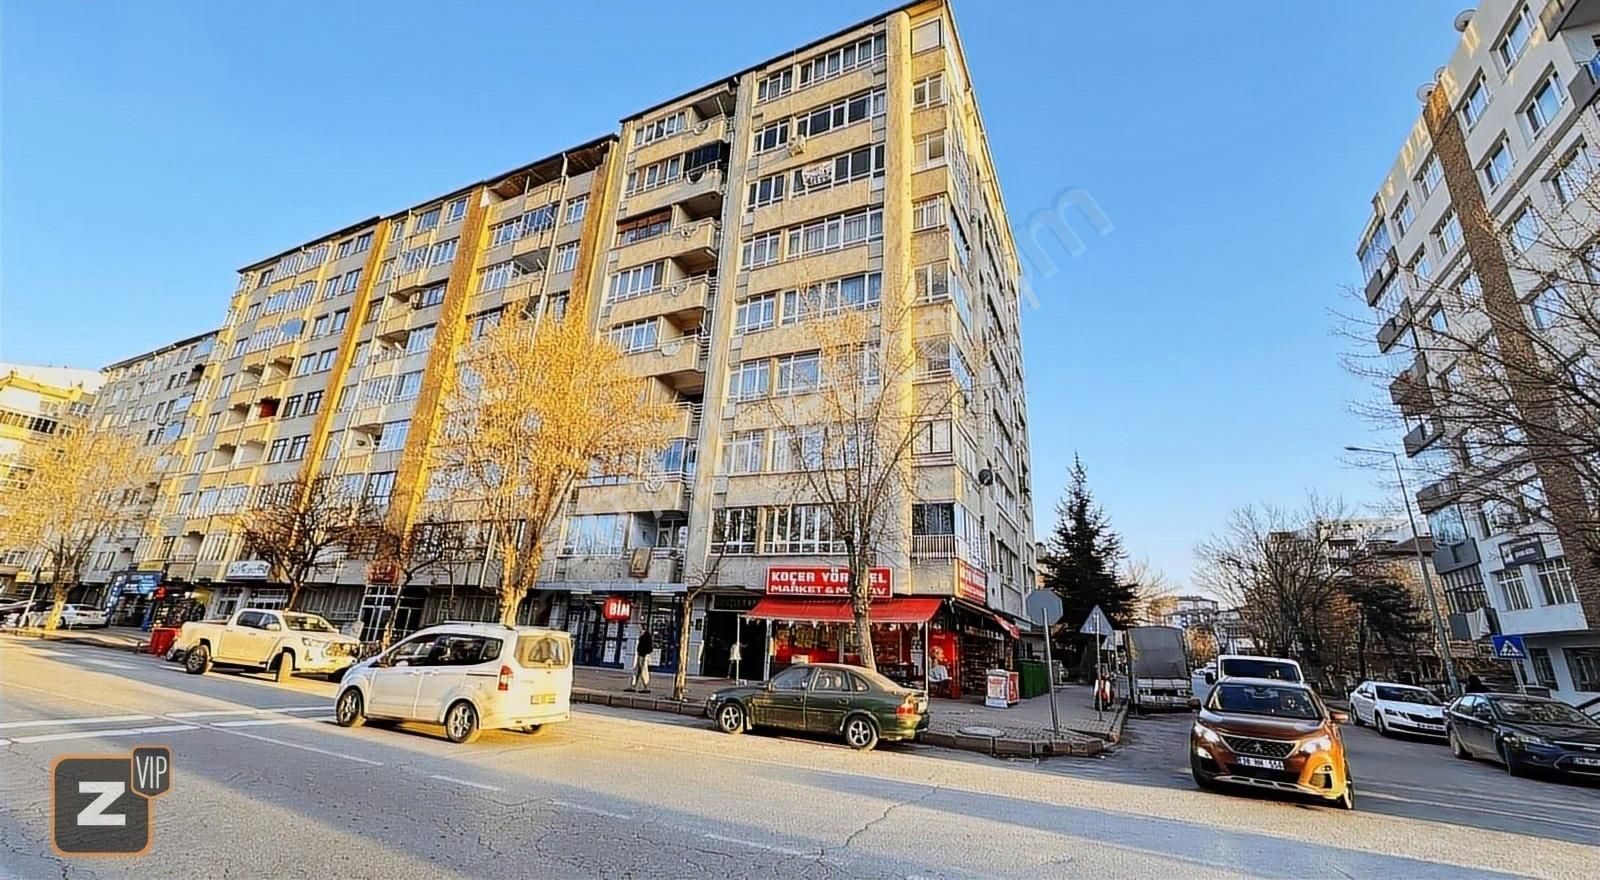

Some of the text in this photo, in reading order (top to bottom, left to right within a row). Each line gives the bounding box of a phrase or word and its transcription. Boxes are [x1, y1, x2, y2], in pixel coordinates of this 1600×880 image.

[771, 567, 887, 586] KOÇER YÖREL
[770, 585, 824, 593] MARKET
[836, 586, 887, 595] MAV
[609, 599, 630, 617] BİM
